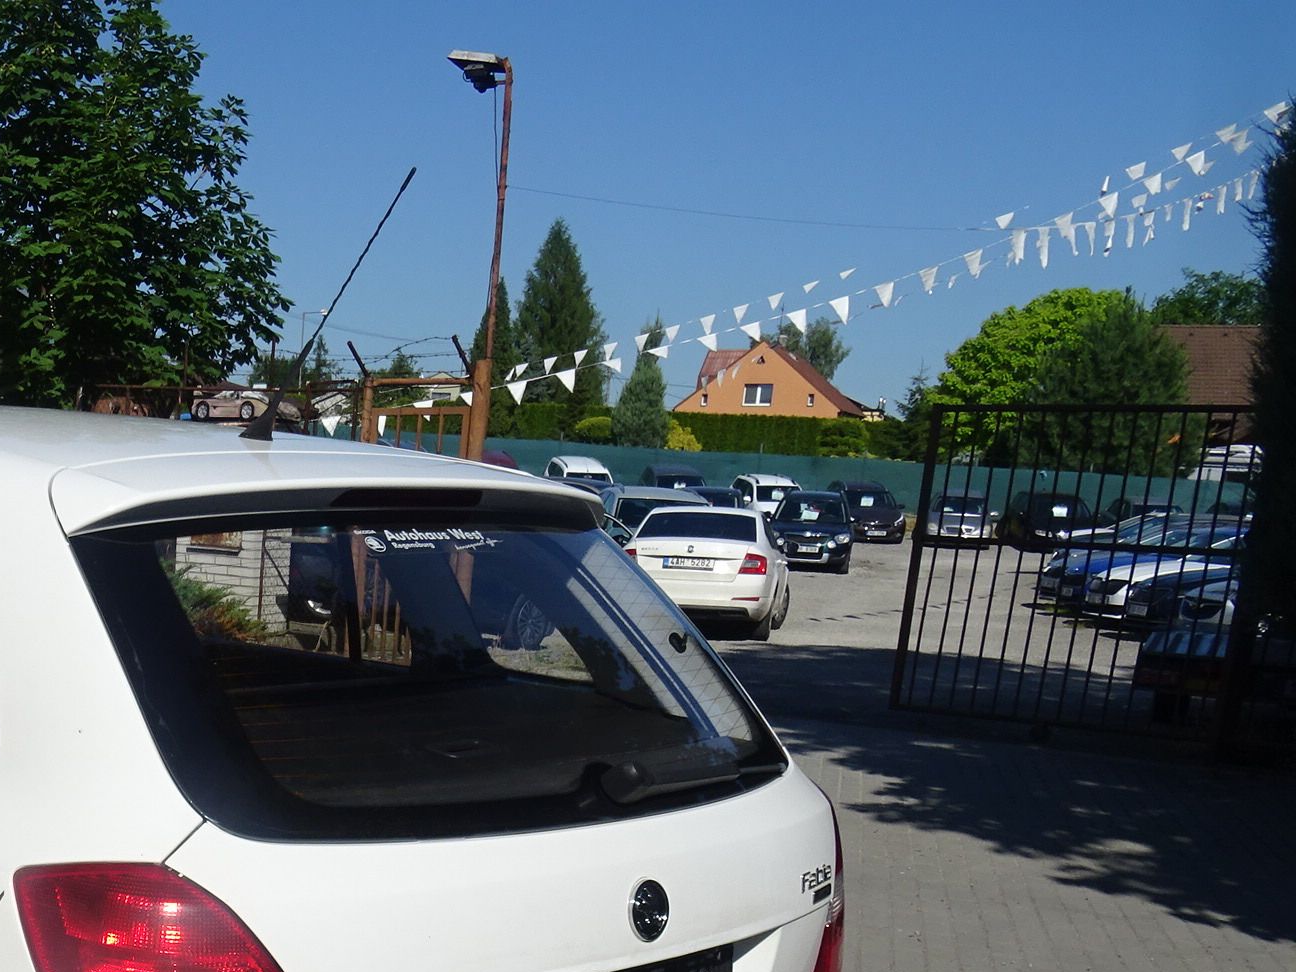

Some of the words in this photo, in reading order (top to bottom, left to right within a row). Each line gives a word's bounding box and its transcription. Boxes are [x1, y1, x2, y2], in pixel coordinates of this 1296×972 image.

[383, 528, 450, 542] Autohaus
[447, 528, 484, 540] West
[391, 541, 436, 550] Regensburg
[801, 863, 832, 894] Fabia
